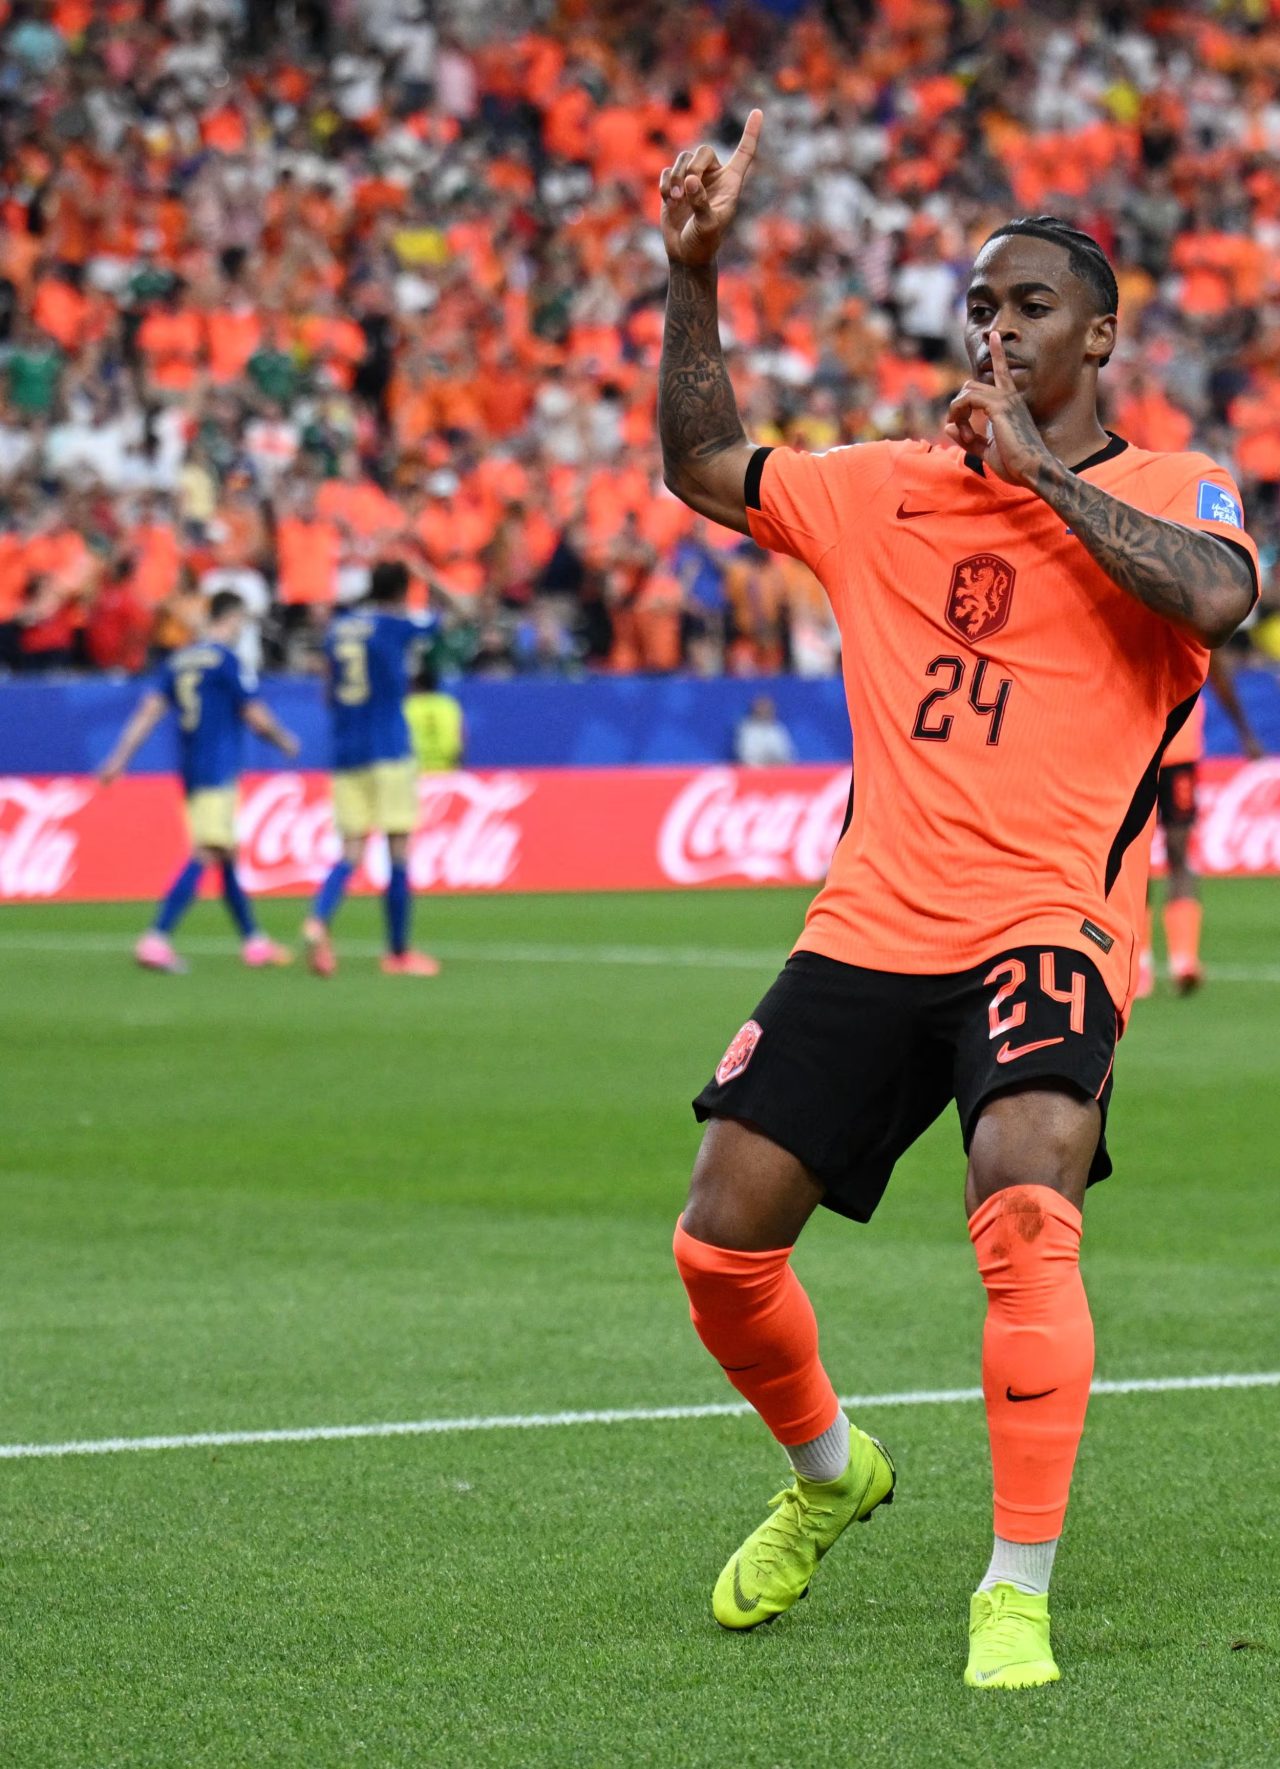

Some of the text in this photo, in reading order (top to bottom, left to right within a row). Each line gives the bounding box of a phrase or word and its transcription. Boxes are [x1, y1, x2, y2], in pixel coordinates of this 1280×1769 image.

[335, 641, 370, 707] 3
[910, 654, 1013, 746] 24
[983, 952, 1086, 1040] 24
